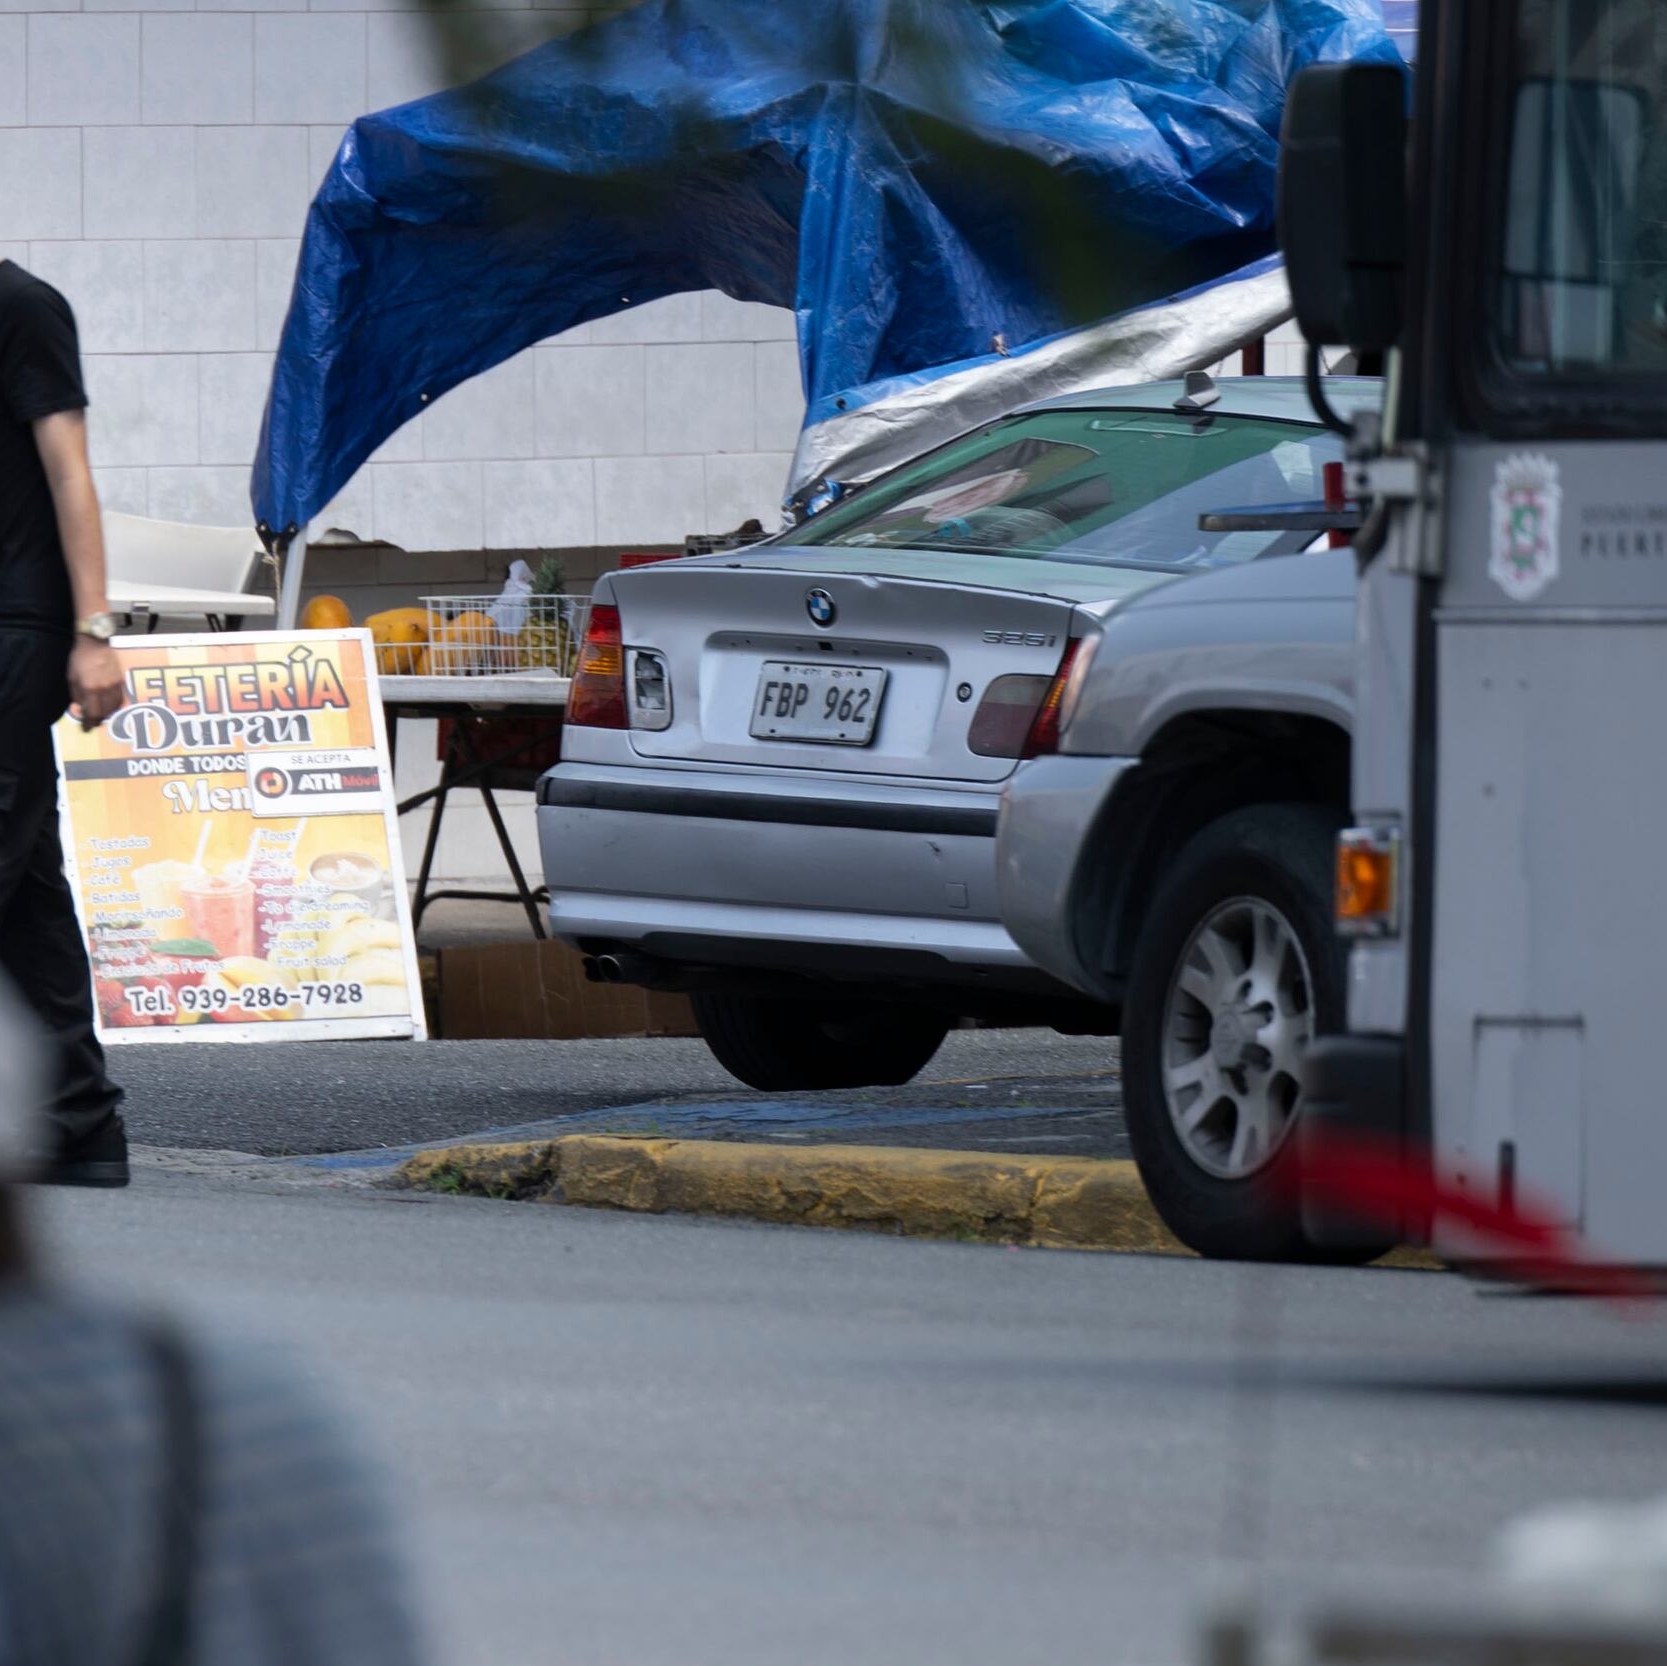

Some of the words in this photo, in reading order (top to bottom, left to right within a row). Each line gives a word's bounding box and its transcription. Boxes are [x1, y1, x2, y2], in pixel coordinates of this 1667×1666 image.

[981, 629, 1057, 648] 325i
[70, 645, 350, 719] FETERÍA
[759, 682, 809, 719] FBP
[823, 686, 871, 723] 962
[112, 704, 312, 750] Duran
[127, 757, 185, 776] DONDE
[192, 755, 248, 773] TODOS
[291, 756, 304, 765] SE
[307, 754, 351, 764] ACEPTA
[297, 773, 343, 792] ATH
[162, 779, 252, 814] Men
[91, 837, 149, 850] Tostadas
[260, 830, 296, 841] Toast
[91, 856, 130, 871] Jugos
[129, 990, 172, 1012] Tel.
[182, 984, 363, 1010] 939-286-7928
